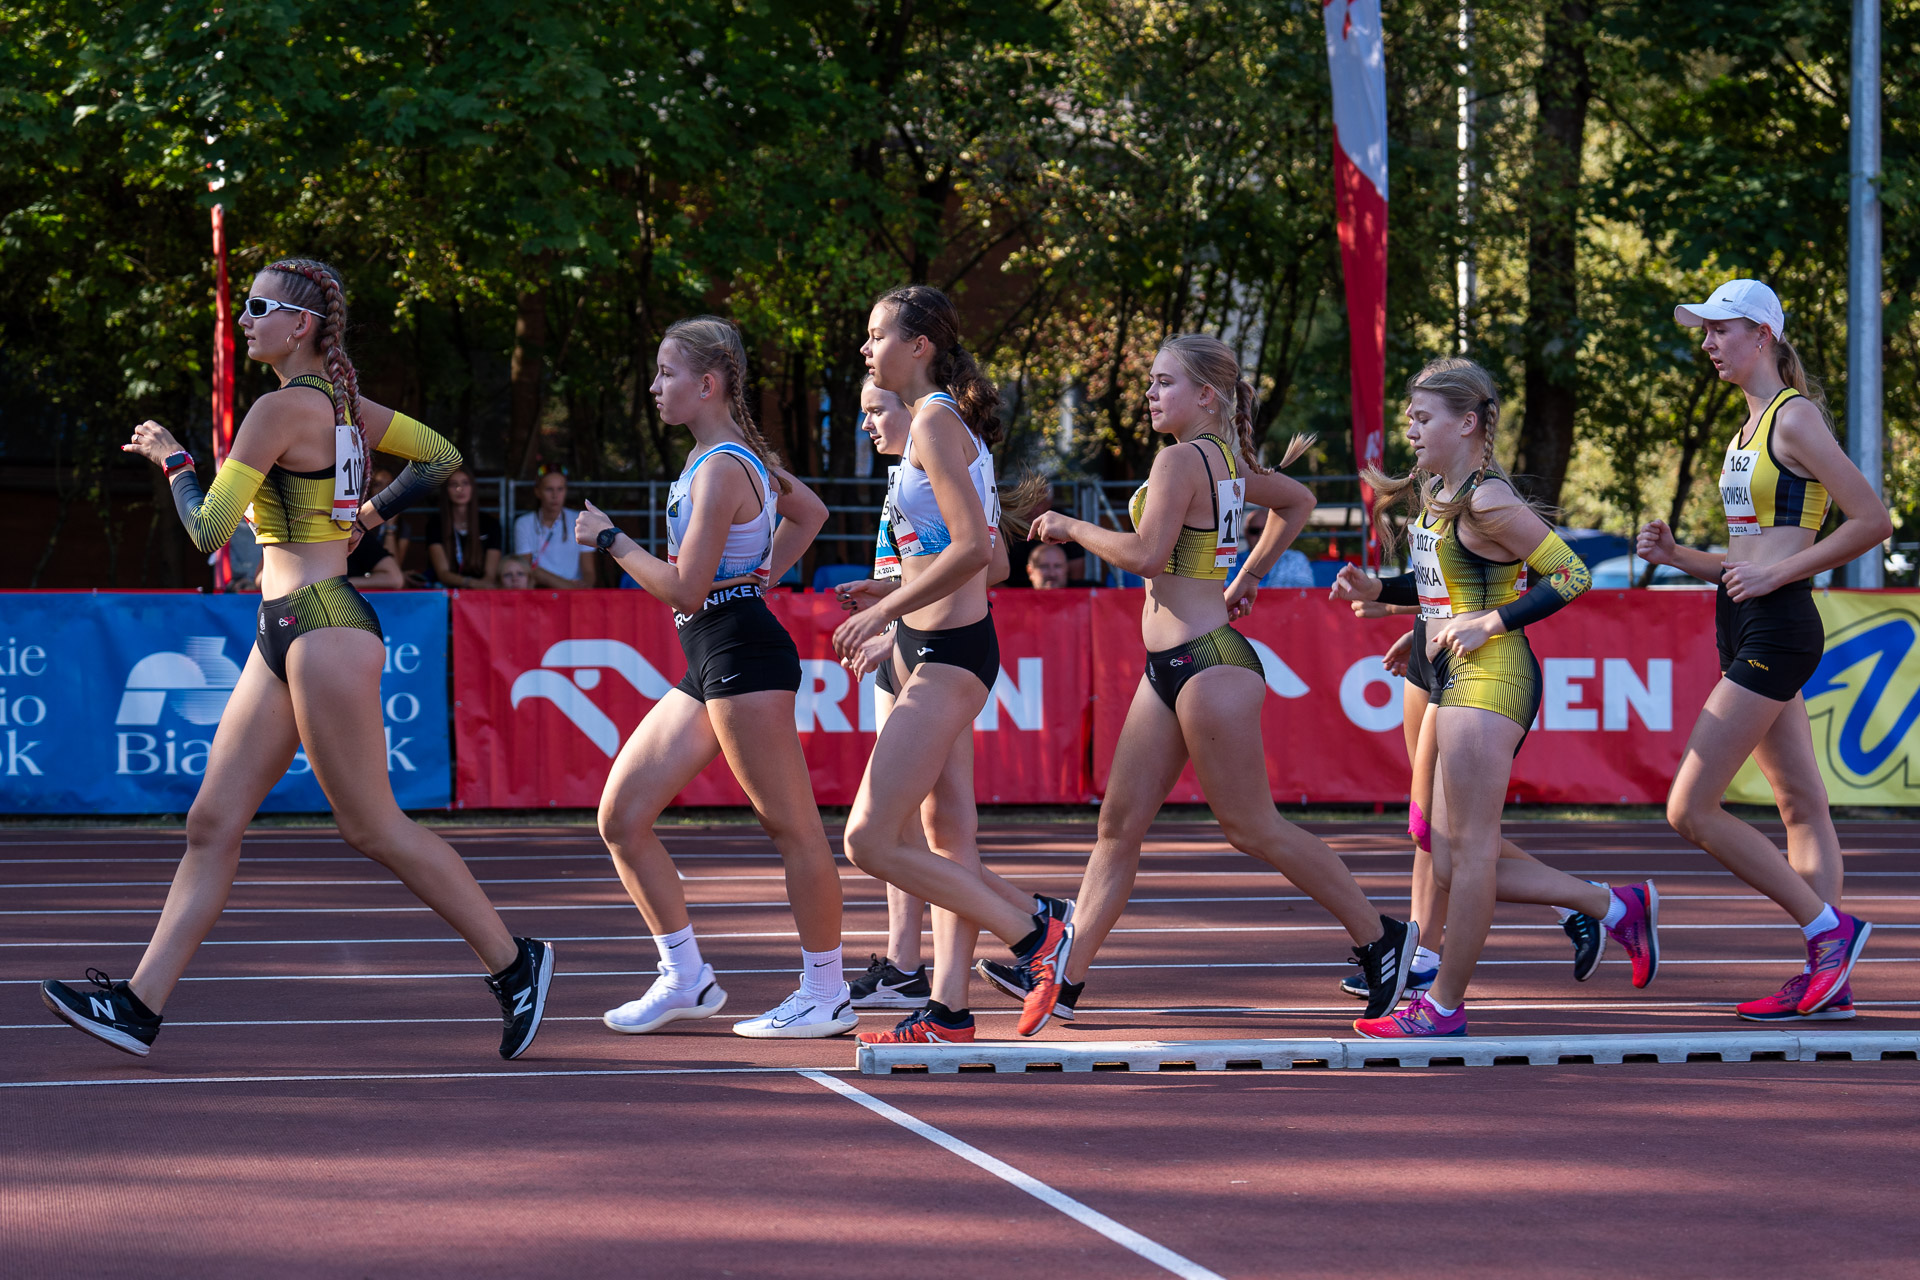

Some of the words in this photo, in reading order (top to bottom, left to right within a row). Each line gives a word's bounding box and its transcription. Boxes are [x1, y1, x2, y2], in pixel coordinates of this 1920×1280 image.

[1730, 456, 1750, 472] 162
[1721, 486, 1750, 505] NOWSKA
[1416, 533, 1436, 552] 1027
[703, 585, 753, 611] NIKE
